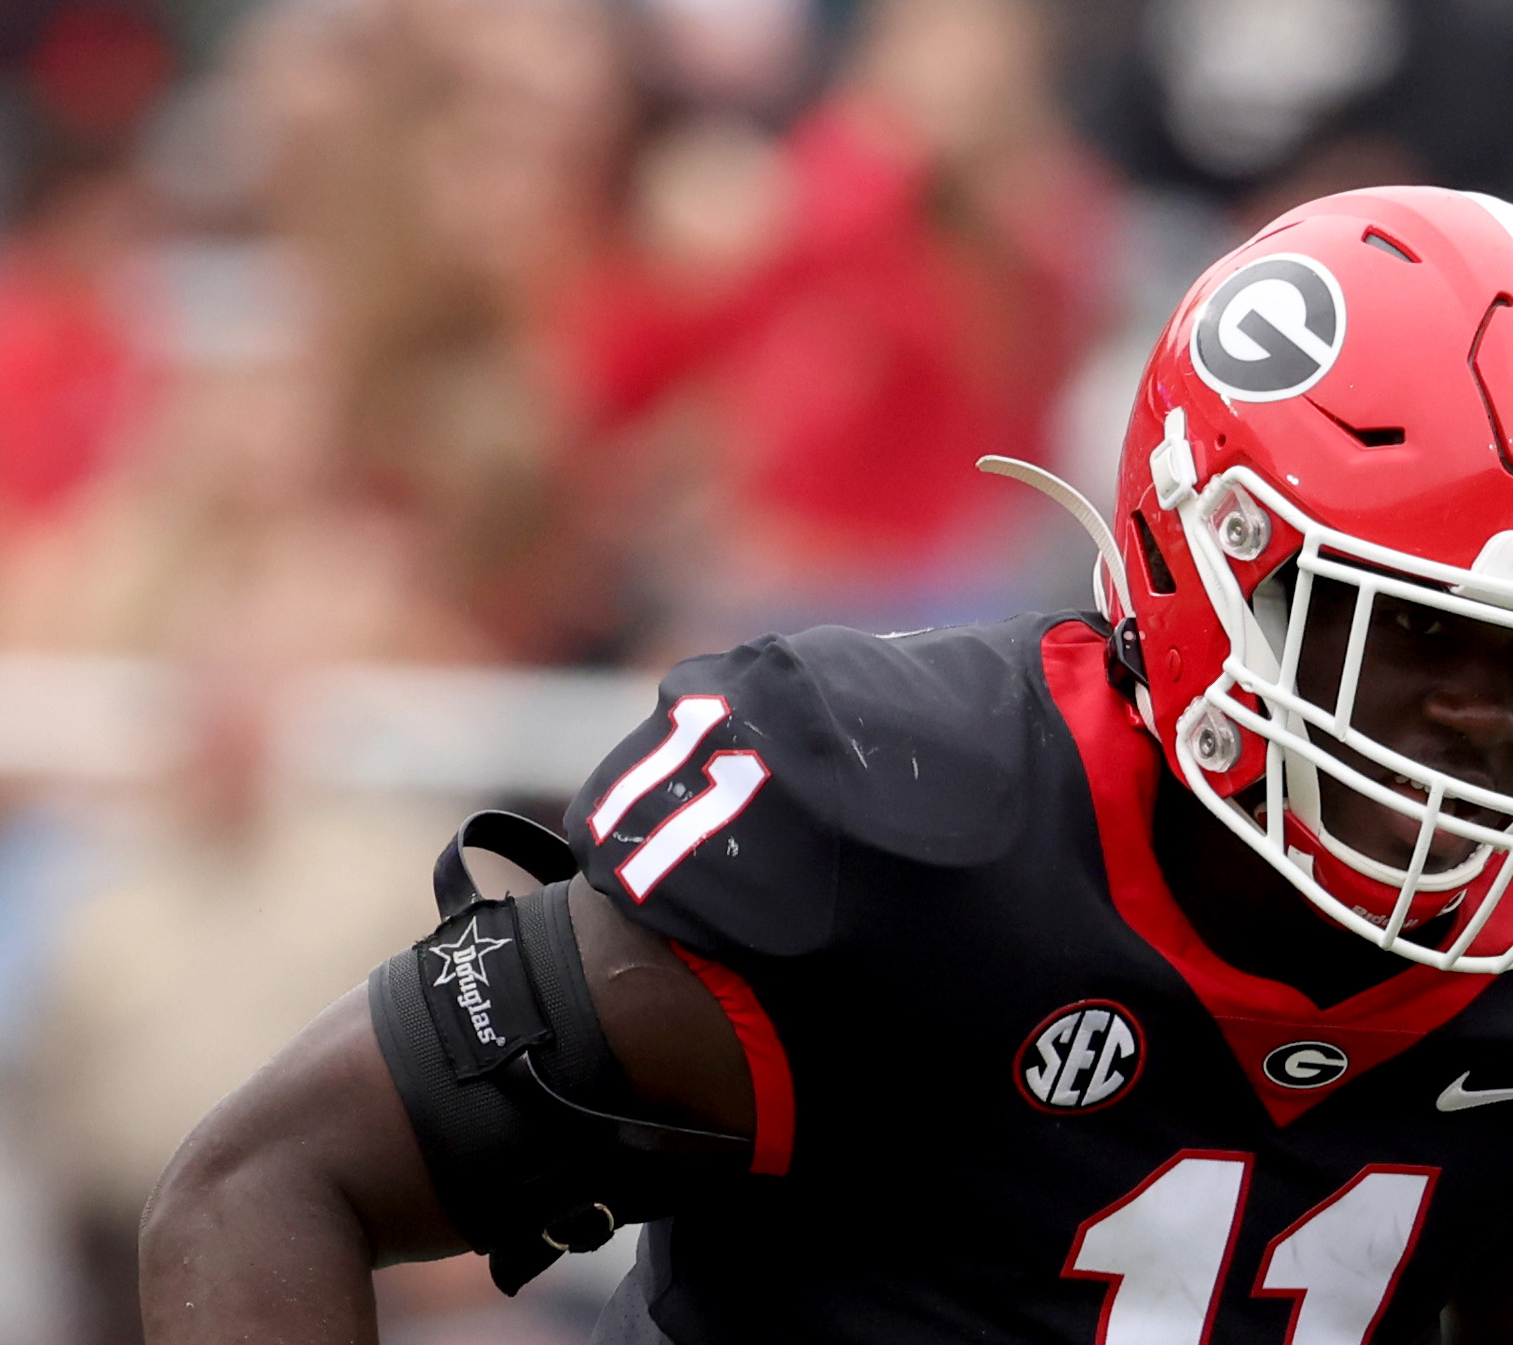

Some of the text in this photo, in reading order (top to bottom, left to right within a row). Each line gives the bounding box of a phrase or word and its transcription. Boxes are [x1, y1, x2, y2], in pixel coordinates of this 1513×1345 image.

[588, 695, 772, 905] 11
[451, 944, 498, 1045] Douglas
[1024, 1009, 1135, 1106] SEC
